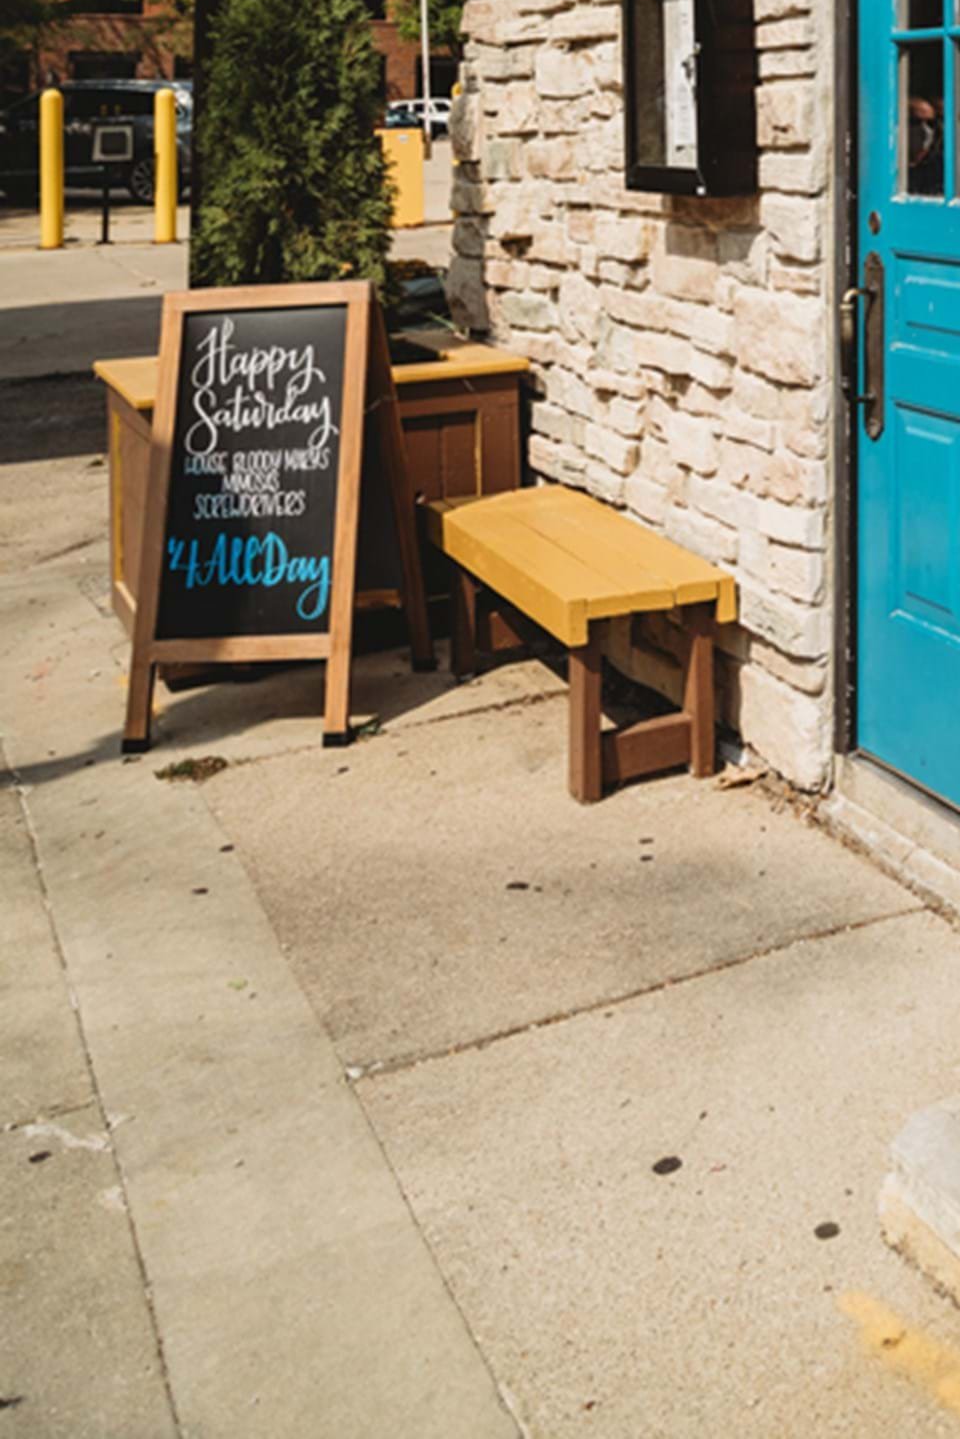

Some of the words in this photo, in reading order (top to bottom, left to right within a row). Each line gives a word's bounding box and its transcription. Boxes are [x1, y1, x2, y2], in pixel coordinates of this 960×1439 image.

[191, 316, 326, 395] Happy
[184, 383, 339, 456] Saturday
[197, 531, 262, 586] All
[261, 531, 331, 620] Day
